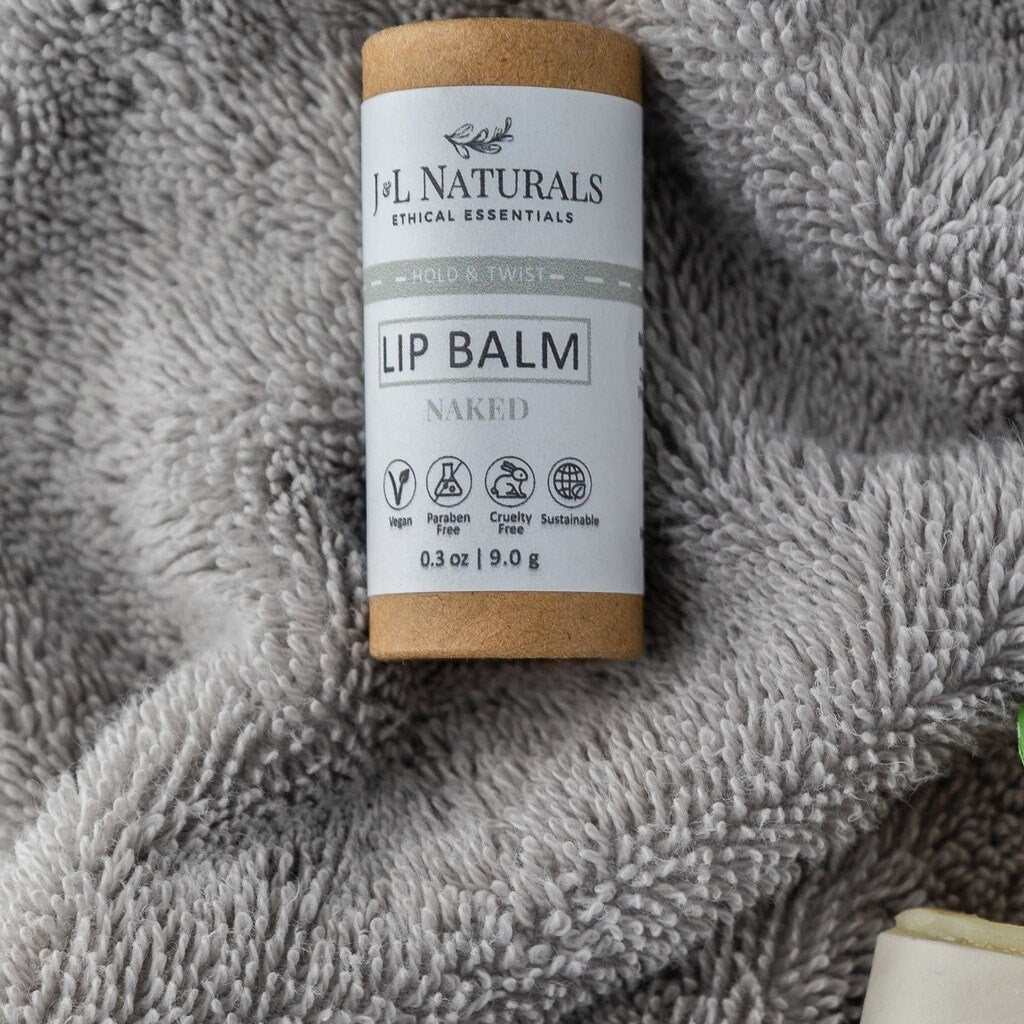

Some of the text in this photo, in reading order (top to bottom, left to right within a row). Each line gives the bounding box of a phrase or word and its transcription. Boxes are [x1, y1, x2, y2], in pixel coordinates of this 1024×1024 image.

[373, 164, 603, 216] J&L NATURALS
[392, 209, 574, 226] ETHICAL ESSENTIALS
[412, 266, 551, 281] HOLD & TWIST
[382, 330, 579, 373] LIP BALM
[426, 397, 529, 422] NAKED
[389, 516, 412, 528] Vegan
[427, 513, 470, 524] Paraben
[490, 512, 532, 524] Cruelty
[541, 514, 599, 526] Sustainable
[437, 524, 460, 535] Free
[498, 524, 524, 535] Free
[420, 551, 444, 567] 0.3
[450, 555, 469, 567] oz
[490, 549, 521, 565] 9.0
[529, 552, 540, 569] g
